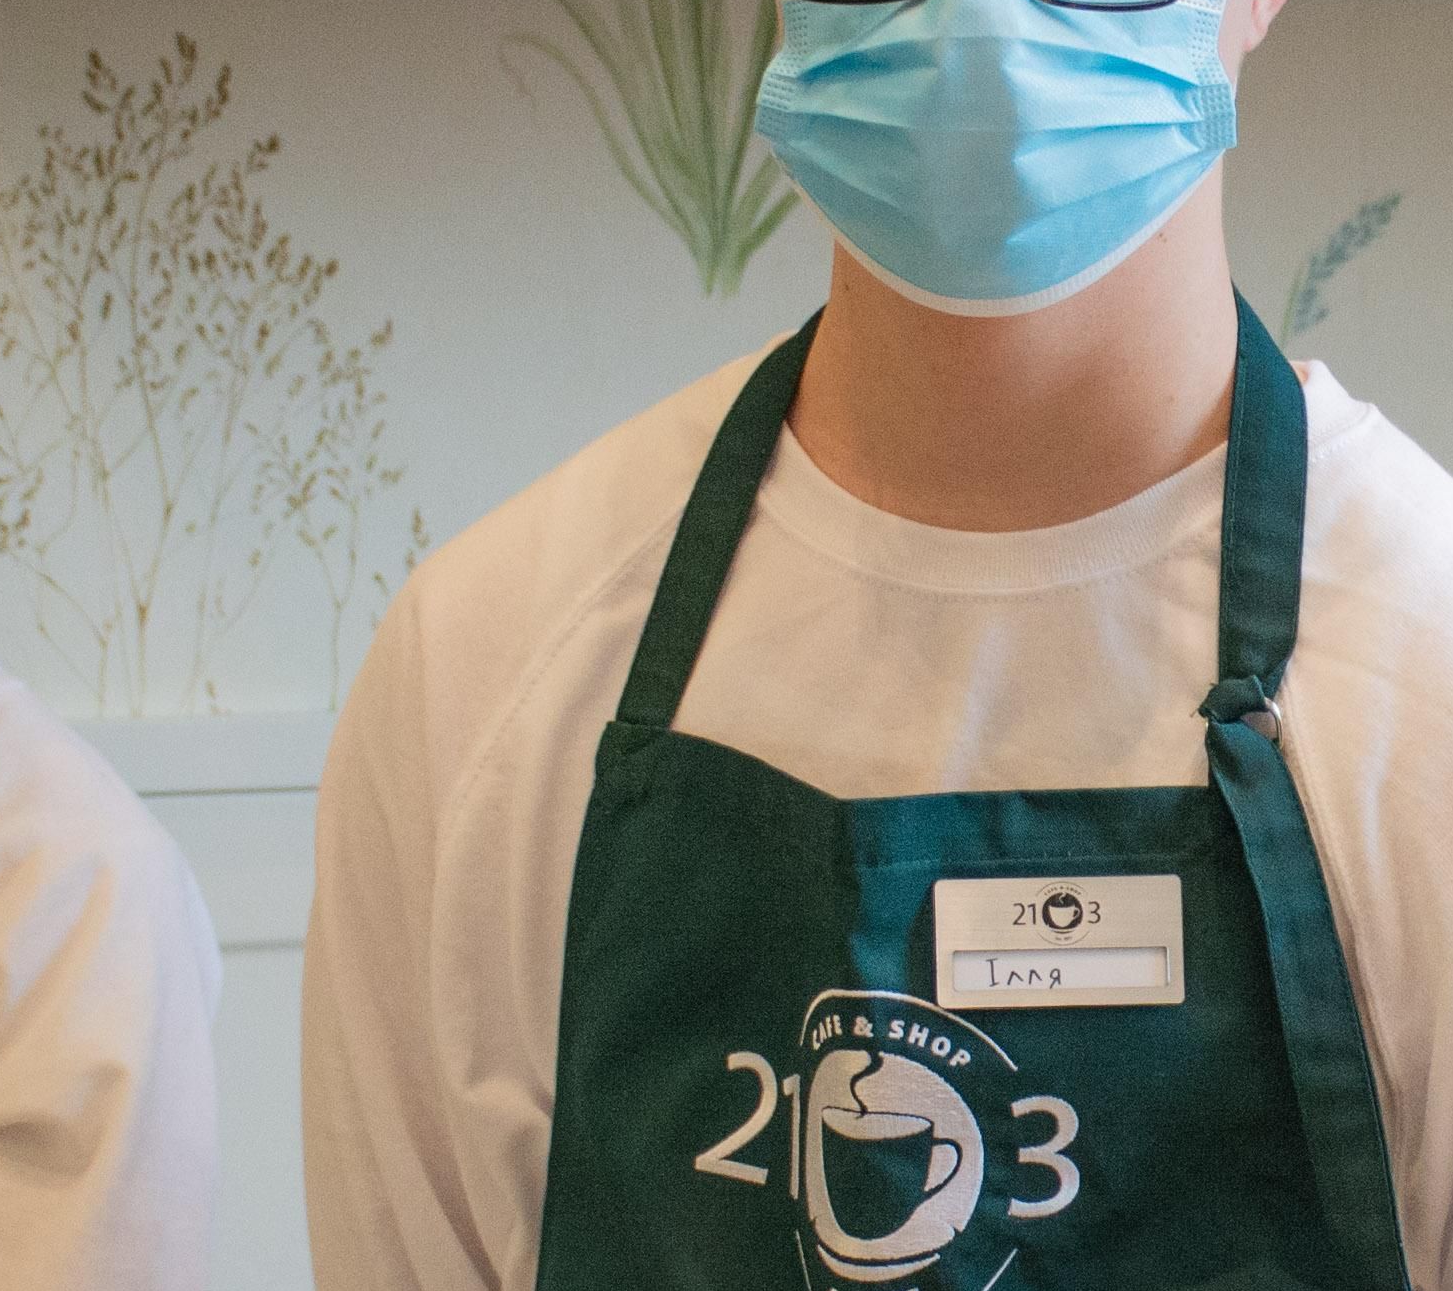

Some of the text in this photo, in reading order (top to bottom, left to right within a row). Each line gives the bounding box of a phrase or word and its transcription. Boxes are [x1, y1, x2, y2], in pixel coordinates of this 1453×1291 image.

[853, 1016, 875, 1038] &
[888, 1019, 972, 1067] SHOP
[693, 1050, 1081, 1219] 21 3
